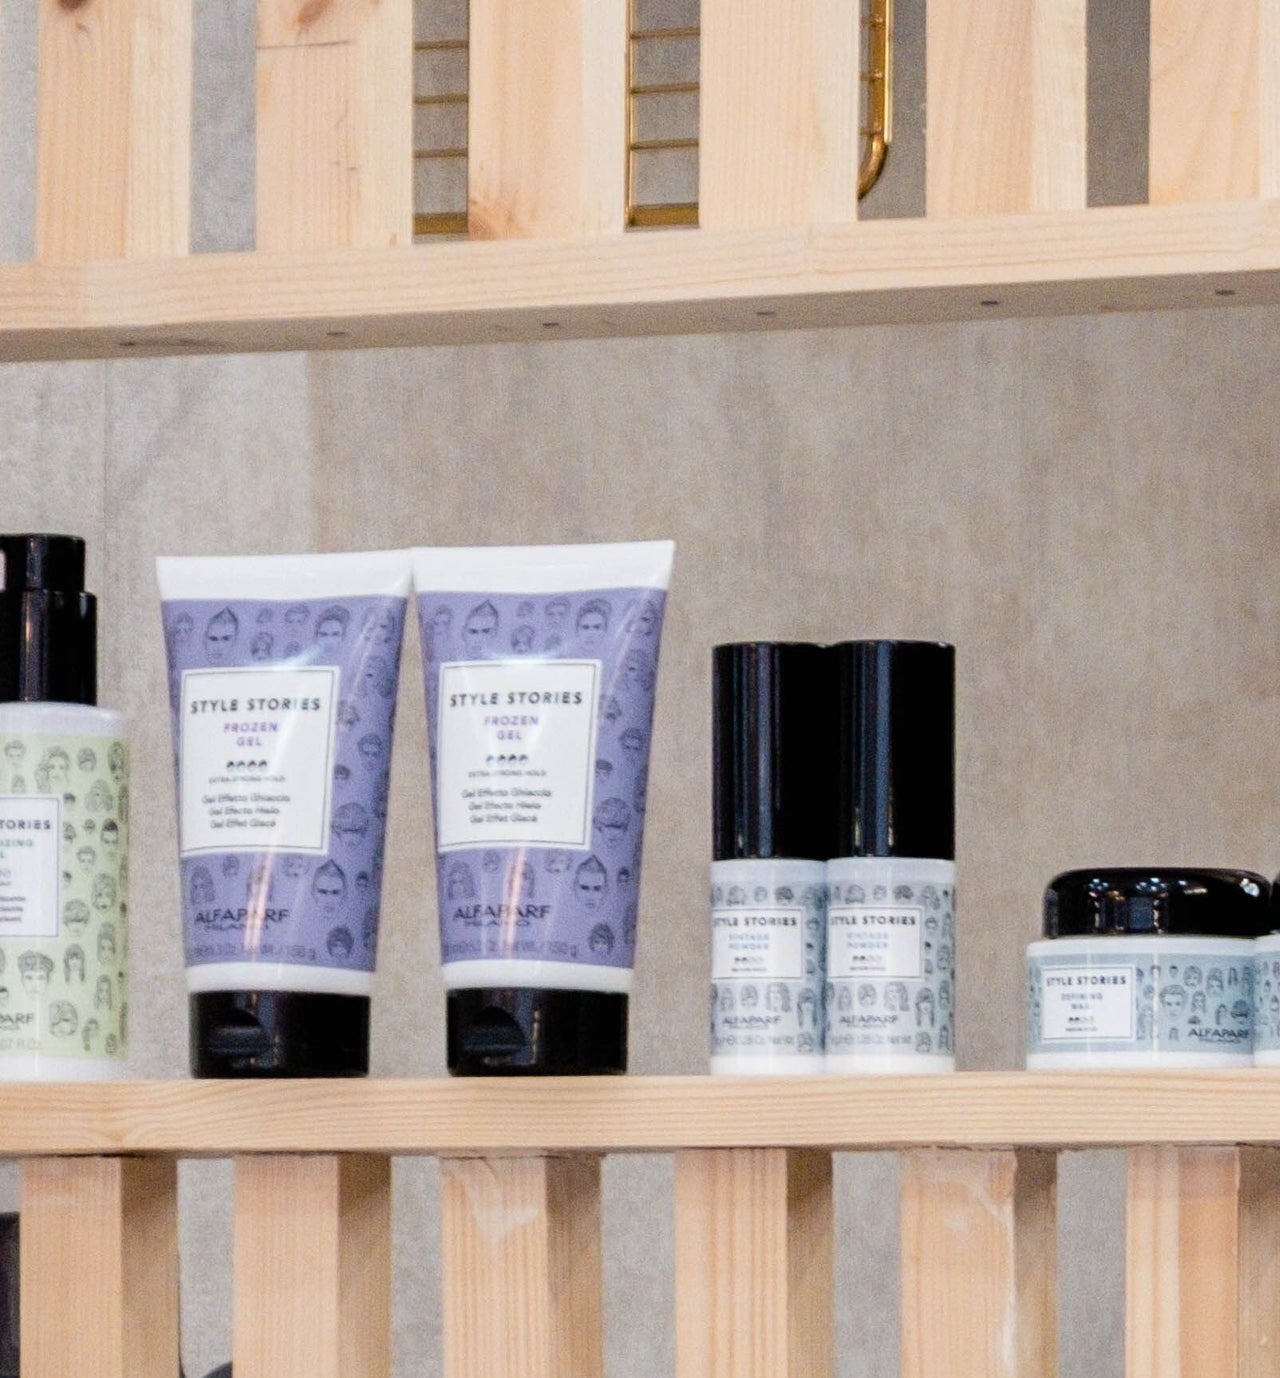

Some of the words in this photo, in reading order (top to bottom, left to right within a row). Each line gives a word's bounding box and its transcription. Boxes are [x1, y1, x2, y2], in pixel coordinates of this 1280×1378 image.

[450, 692, 498, 707] STYLE
[507, 691, 583, 704] STORIES
[191, 699, 239, 714] STYLE
[246, 698, 321, 711] STORIES
[484, 716, 539, 726] FROZEN
[224, 722, 278, 733] FROZEN
[497, 730, 522, 740] GEL
[237, 736, 262, 746] GEL
[0, 818, 51, 830] TORIES
[744, 916, 798, 927] STORIES
[862, 915, 916, 926] STORIES
[1046, 976, 1073, 986] STYLE
[1077, 975, 1127, 986] STORIES
